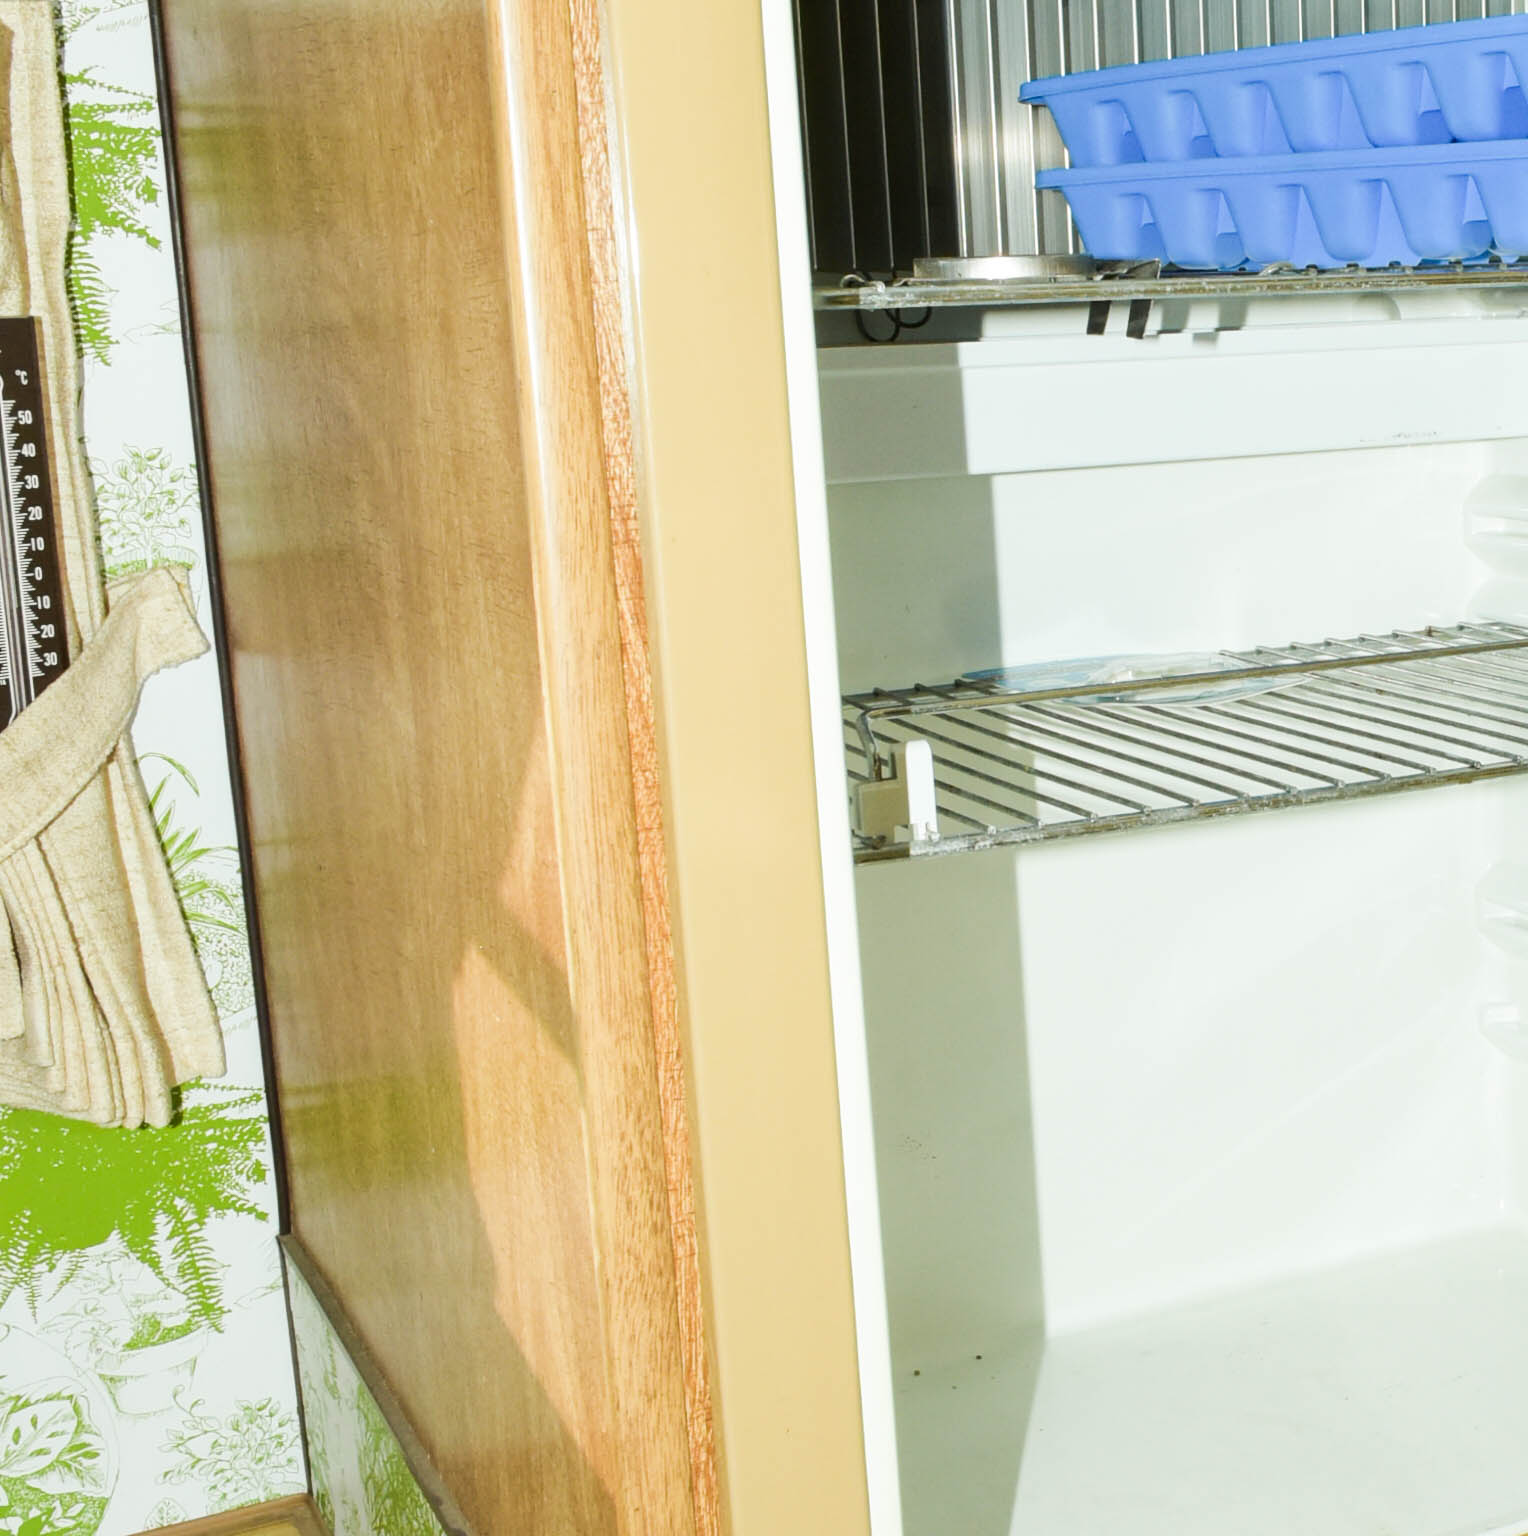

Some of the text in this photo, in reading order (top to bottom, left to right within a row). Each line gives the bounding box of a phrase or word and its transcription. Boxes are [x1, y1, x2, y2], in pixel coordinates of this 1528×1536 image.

[17, 410, 32, 425] 50
[21, 443, 36, 458] 40
[24, 475, 39, 489] 30
[27, 506, 43, 521] 20
[30, 538, 45, 552] 10
[34, 567, 43, 581] 0
[36, 595, 50, 610] 10
[40, 624, 55, 639] 20
[43, 652, 58, 666] 30
